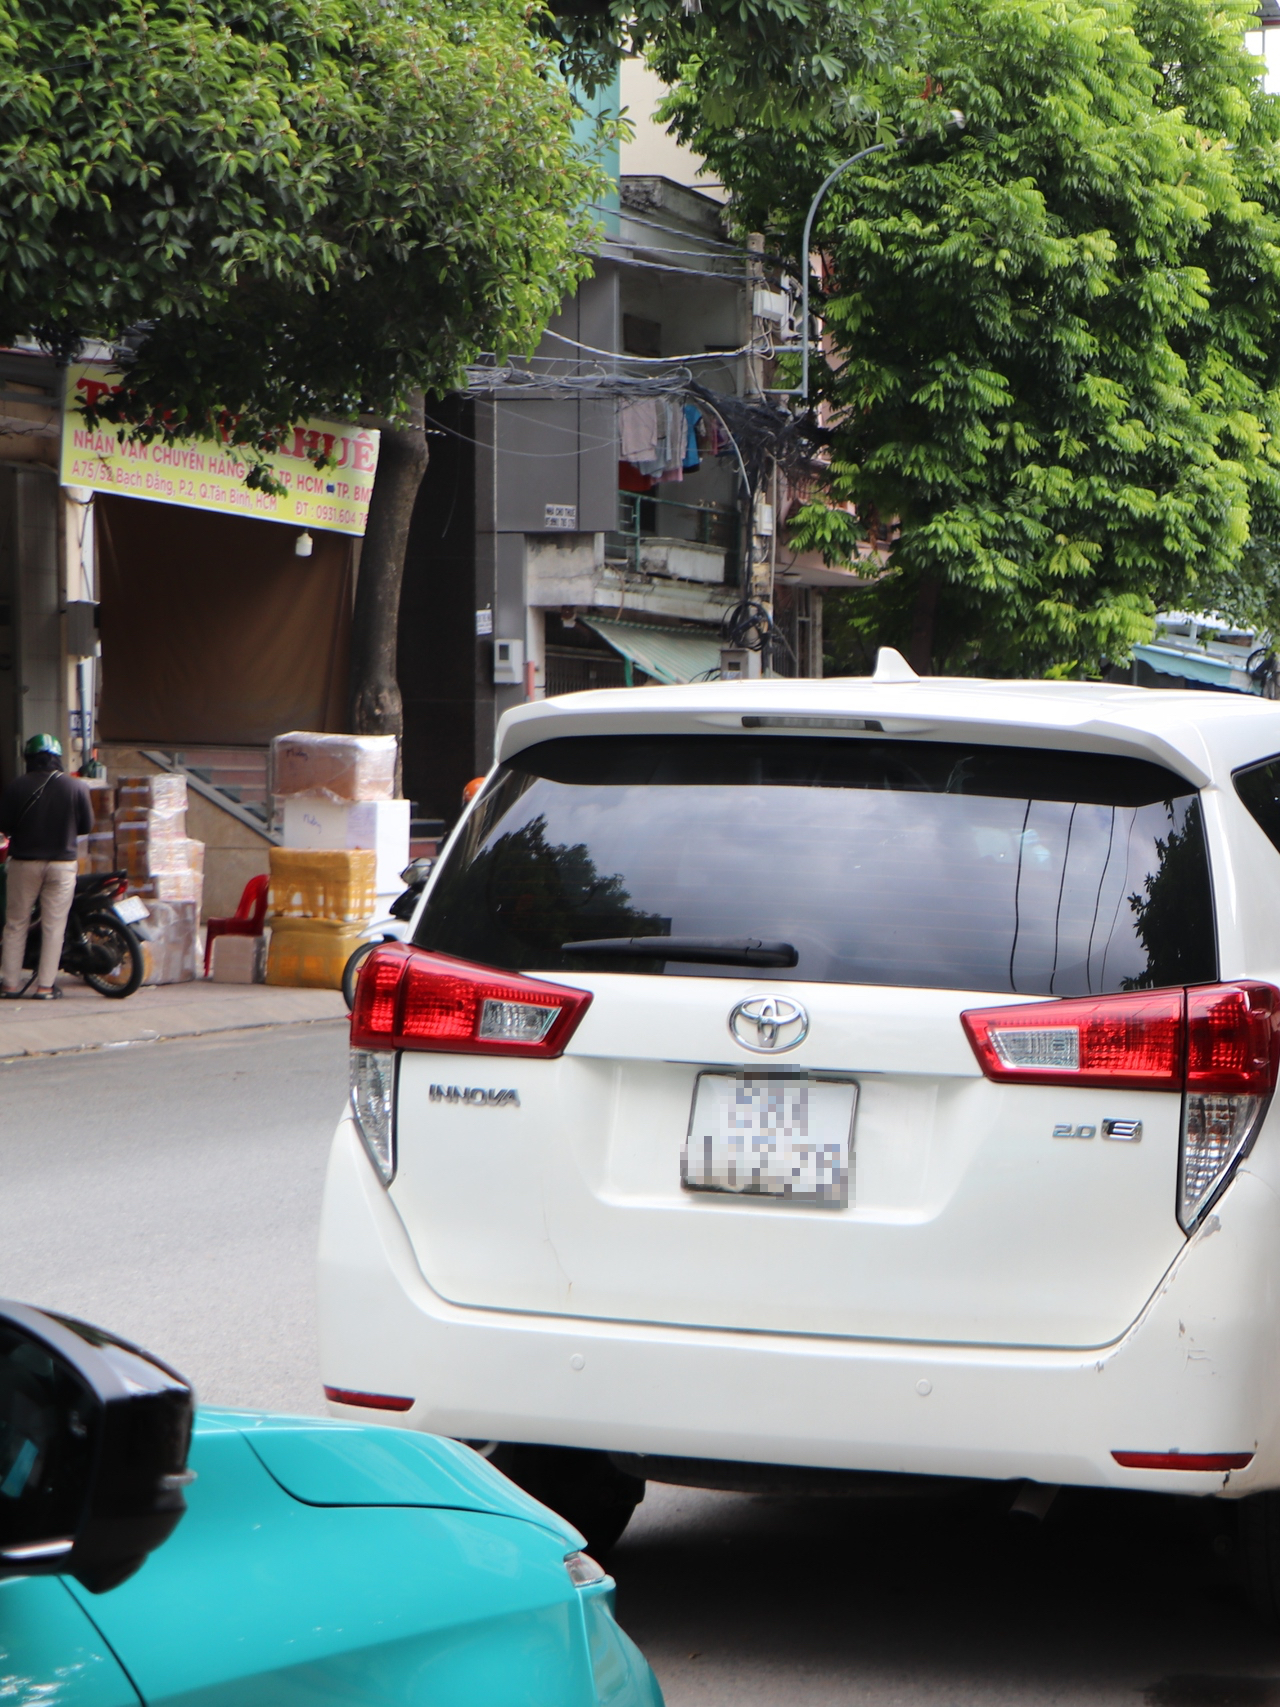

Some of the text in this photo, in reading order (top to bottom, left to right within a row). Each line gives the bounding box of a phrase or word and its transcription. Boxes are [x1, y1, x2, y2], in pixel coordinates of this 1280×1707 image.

[209, 453, 246, 480] HÀNG
[116, 467, 142, 489] Bạch
[255, 493, 277, 511] HCM
[297, 476, 324, 494] HCM
[429, 1083, 521, 1107] INNOVA
[1052, 1123, 1096, 1138] 2.0
